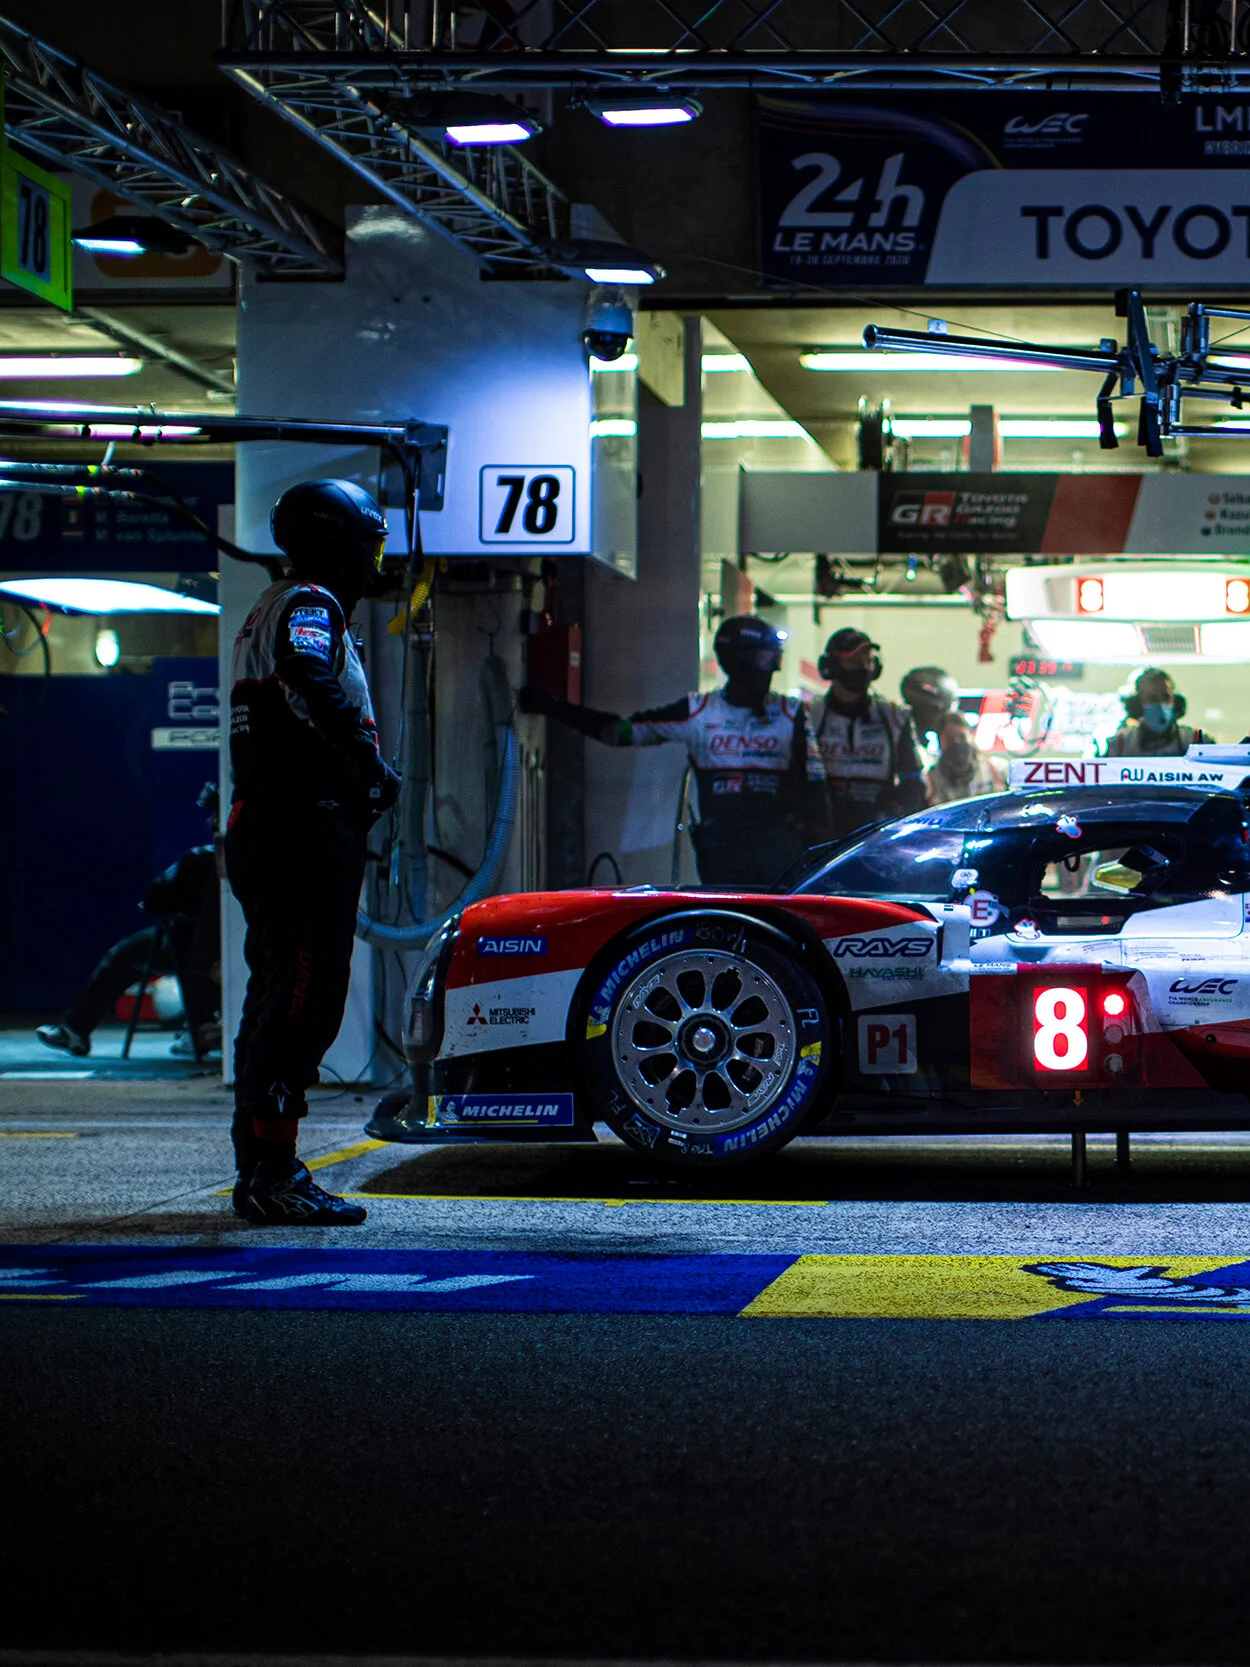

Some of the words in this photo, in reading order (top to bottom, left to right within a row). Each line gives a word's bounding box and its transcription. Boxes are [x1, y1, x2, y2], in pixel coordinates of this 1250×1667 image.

[1002, 113, 1090, 134] WEC
[778, 152, 926, 228] 24h
[20, 184, 46, 273] 78
[772, 232, 814, 252] LE
[819, 232, 917, 252] MANS
[493, 475, 559, 534] 78
[891, 504, 952, 525] GR
[1080, 579, 1103, 612] 8
[1226, 579, 1250, 613] 8
[710, 735, 779, 751] DENSO
[1025, 762, 1107, 783] ZENT
[1147, 771, 1194, 782] AISIN
[1198, 771, 1224, 782] AW
[973, 900, 988, 920] E
[482, 940, 542, 953] AISIN
[833, 938, 934, 958] RAYS
[599, 928, 685, 1000] MICHELIN
[850, 967, 923, 978] HAYASHI
[1168, 978, 1238, 995] WEC
[489, 1007, 536, 1017] MITSUBISHI
[489, 1017, 529, 1025] ELECTRIC
[796, 1007, 819, 1029] FL
[1034, 987, 1088, 1070] 8
[866, 1023, 908, 1066] P1
[461, 1103, 560, 1118] MICHELIN
[722, 1078, 809, 1154] MICHELIN
